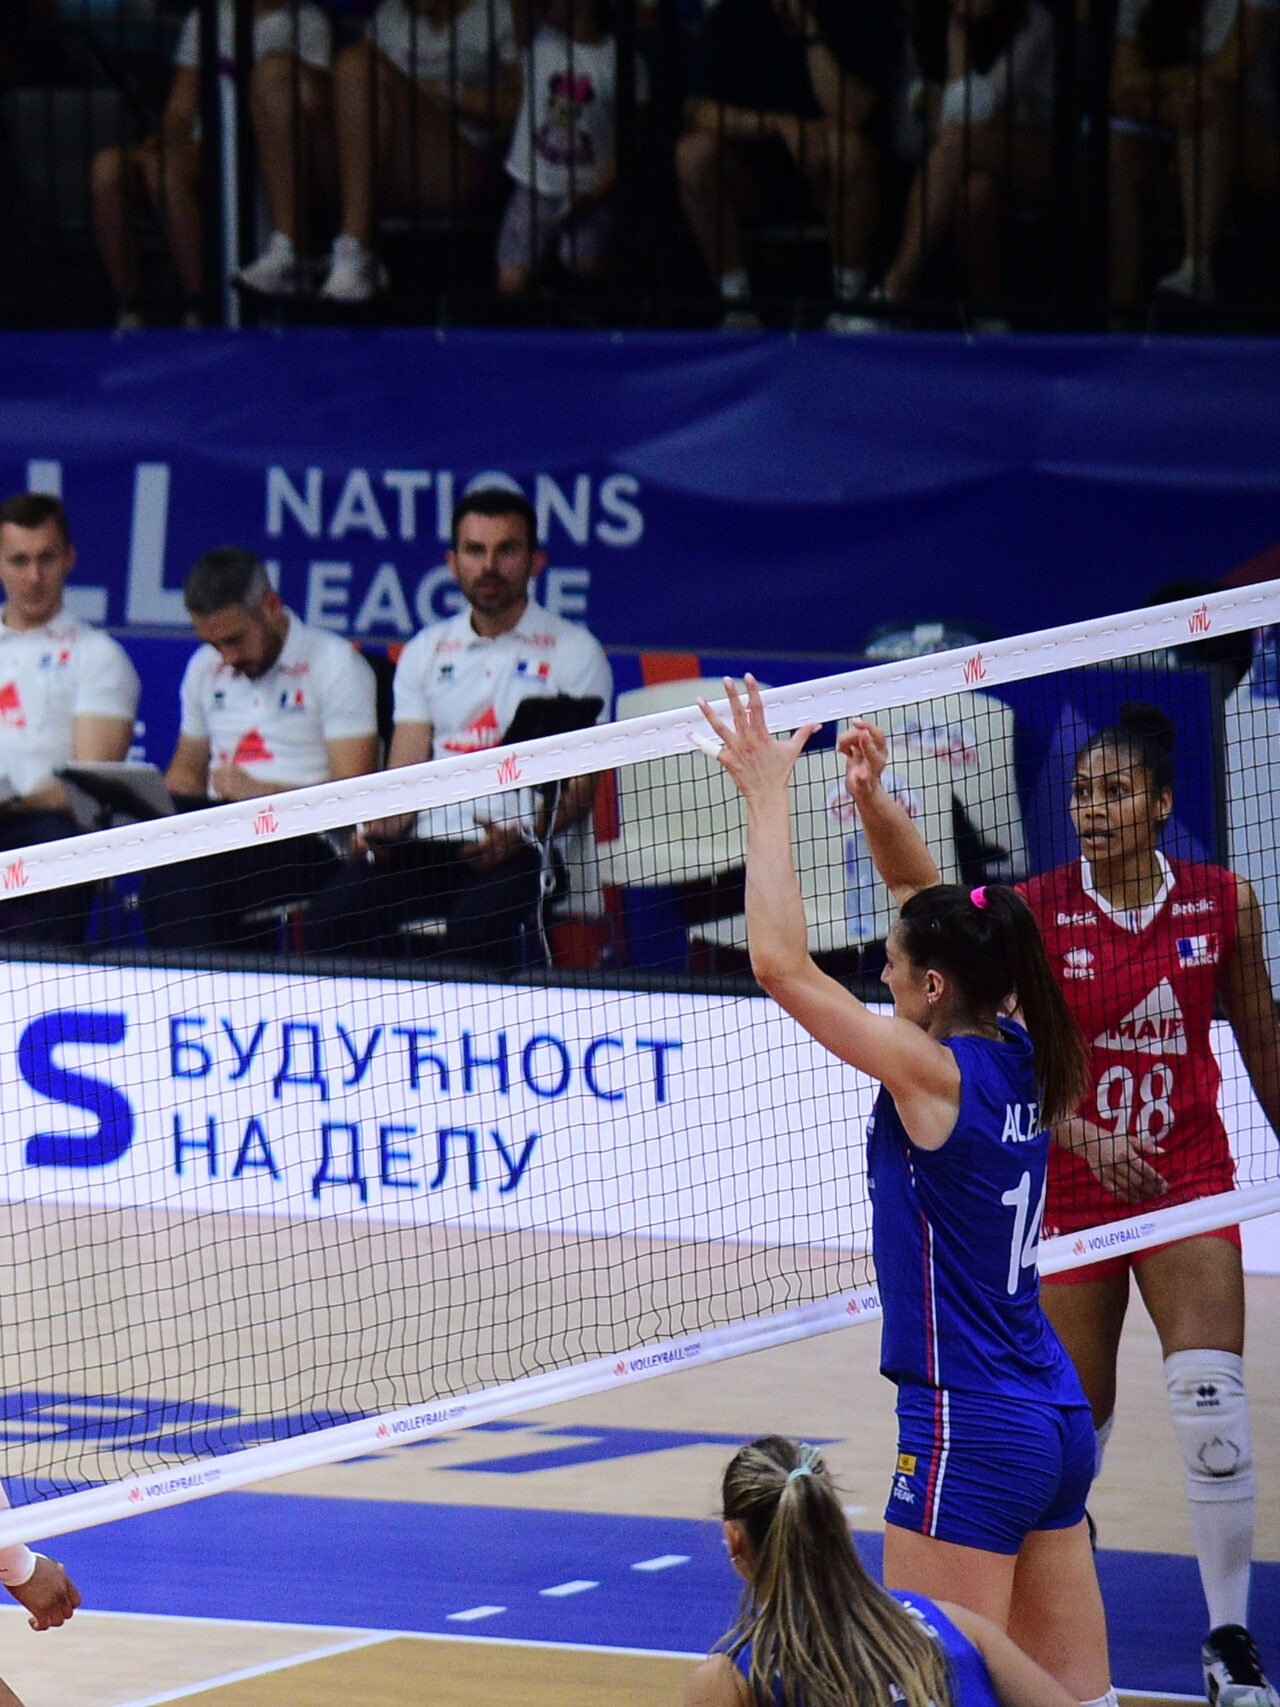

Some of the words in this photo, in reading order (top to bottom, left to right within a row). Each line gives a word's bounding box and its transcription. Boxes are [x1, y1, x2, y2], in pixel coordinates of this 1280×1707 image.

[265, 465, 644, 548] NATINS
[1108, 1017, 1183, 1040] MAIF
[168, 1016, 683, 1104] БУДУЋНОСТ
[1096, 1062, 1175, 1144] 98
[172, 1112, 282, 1181] НА
[312, 1121, 539, 1205] ДЕЛУ
[1087, 1226, 1141, 1251] VOLLEYBALL
[629, 1347, 686, 1372] VOLLEYBALL
[391, 1408, 449, 1434] VOLLEYBALL
[145, 1472, 206, 1498] VOLLEYBALL
